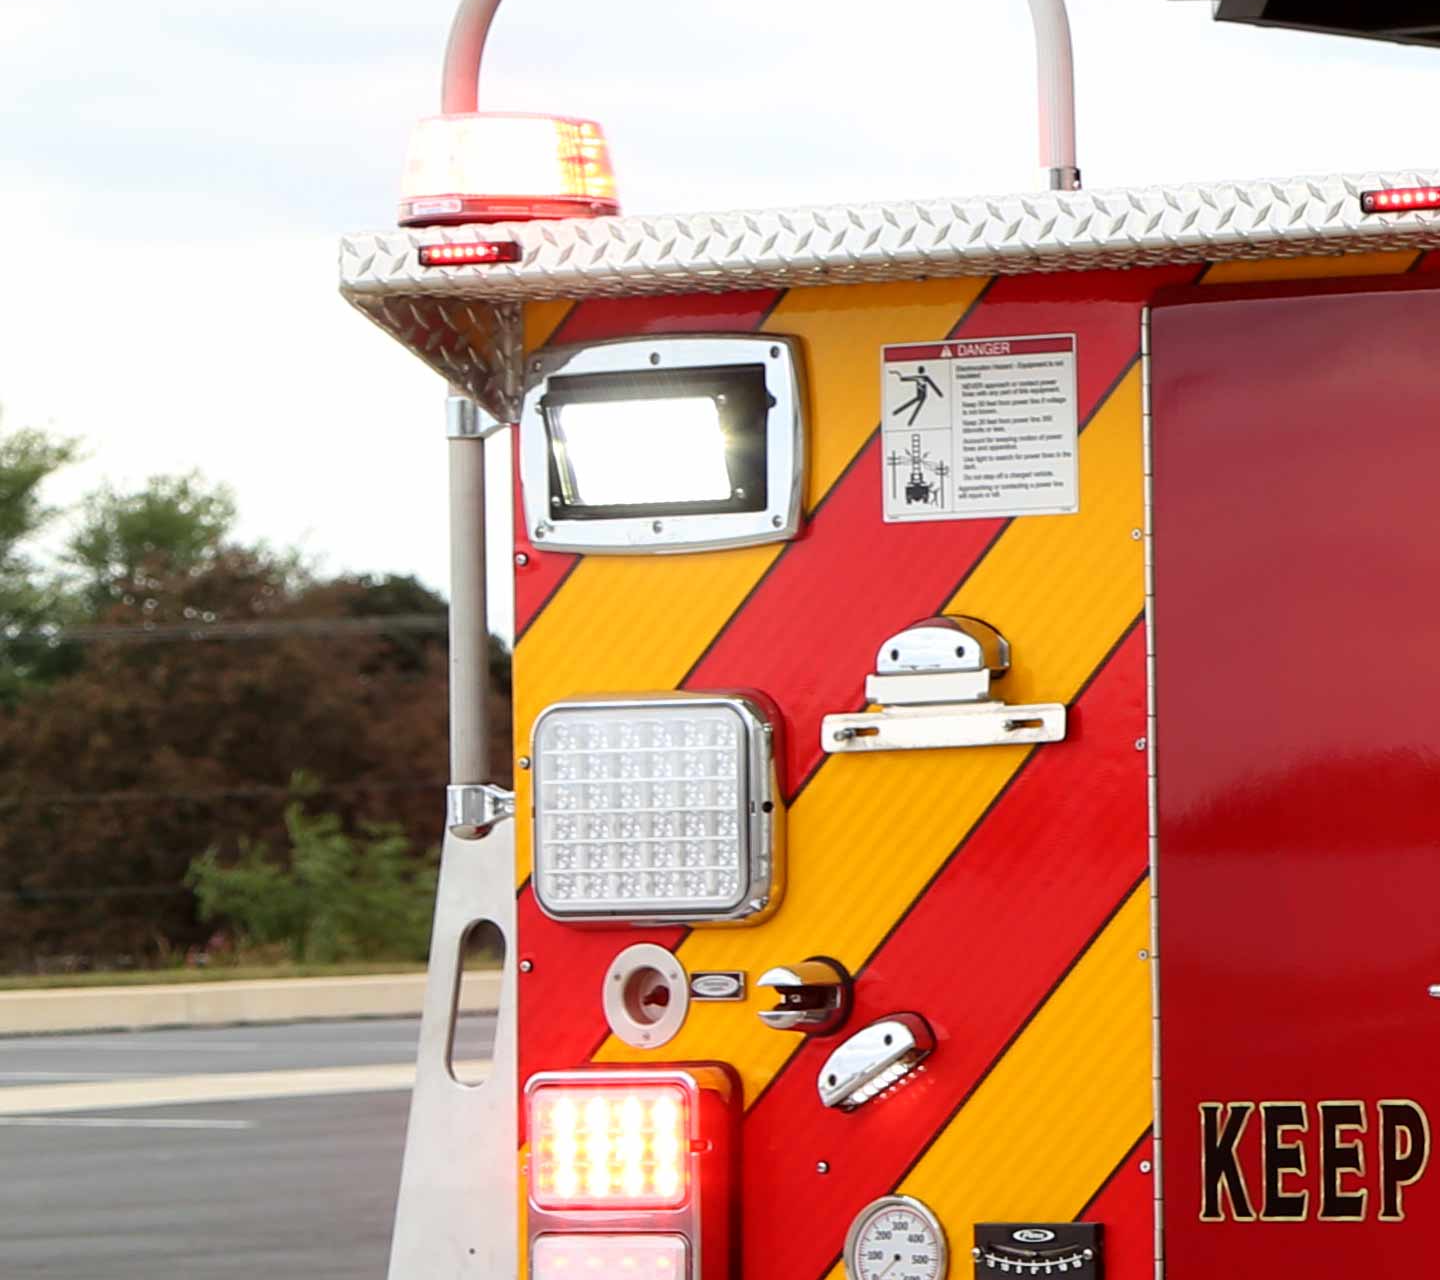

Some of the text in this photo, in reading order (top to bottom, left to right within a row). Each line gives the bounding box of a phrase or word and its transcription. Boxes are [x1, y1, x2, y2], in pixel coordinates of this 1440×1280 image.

[957, 342, 1010, 356] DANGER
[1199, 1098, 1430, 1221] KEEP
[892, 1221, 909, 1231] 300
[875, 1230, 893, 1240] 200
[908, 1233, 925, 1243] 400
[867, 1250, 883, 1260] 100
[911, 1254, 929, 1264] 500
